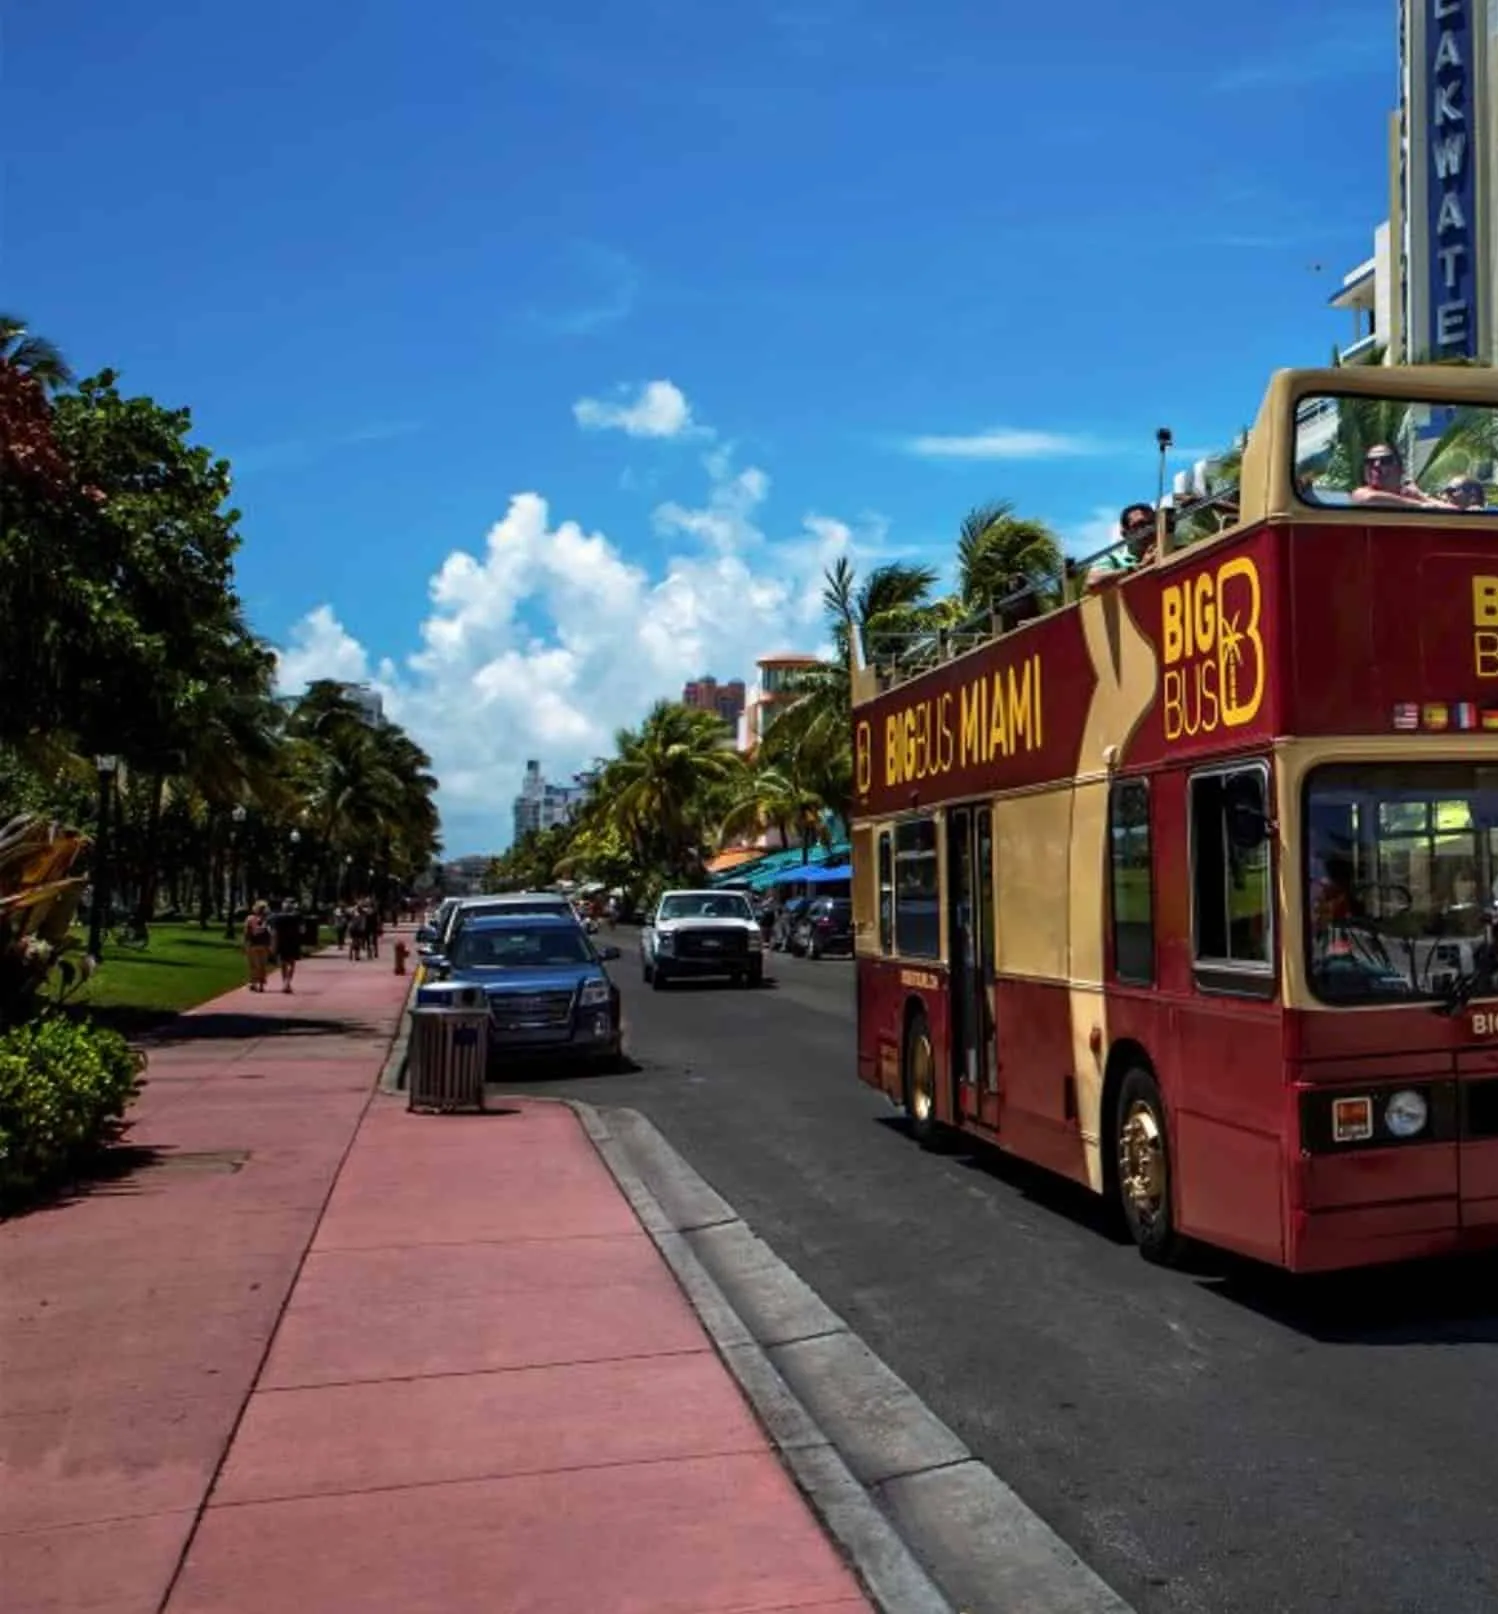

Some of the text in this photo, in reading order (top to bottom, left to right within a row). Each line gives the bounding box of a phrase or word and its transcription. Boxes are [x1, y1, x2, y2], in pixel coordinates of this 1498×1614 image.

[1161, 571, 1216, 664] BIG
[960, 653, 1042, 769] MIAMI
[1163, 659, 1219, 740] BUS
